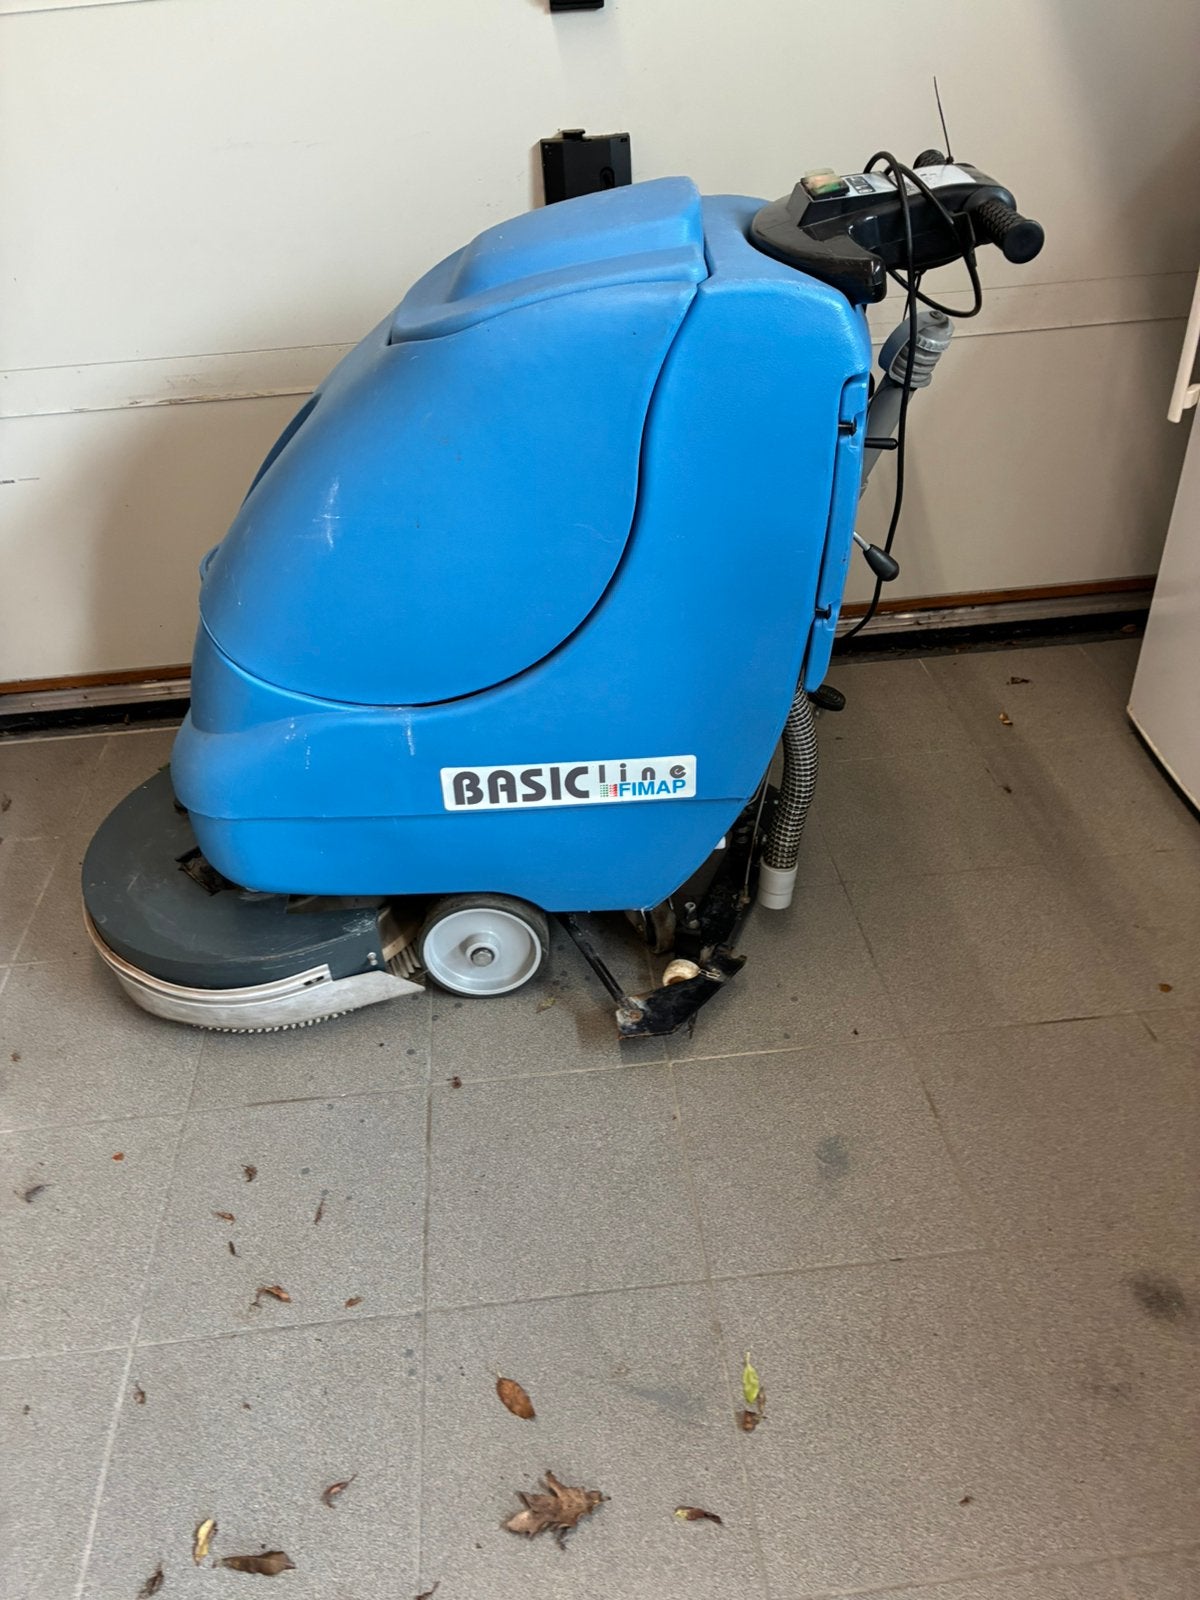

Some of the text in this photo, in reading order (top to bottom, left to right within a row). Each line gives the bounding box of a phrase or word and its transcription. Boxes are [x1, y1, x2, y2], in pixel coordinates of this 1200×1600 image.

[453, 763, 687, 805] BASIC line
[619, 779, 686, 797] FIMAP
